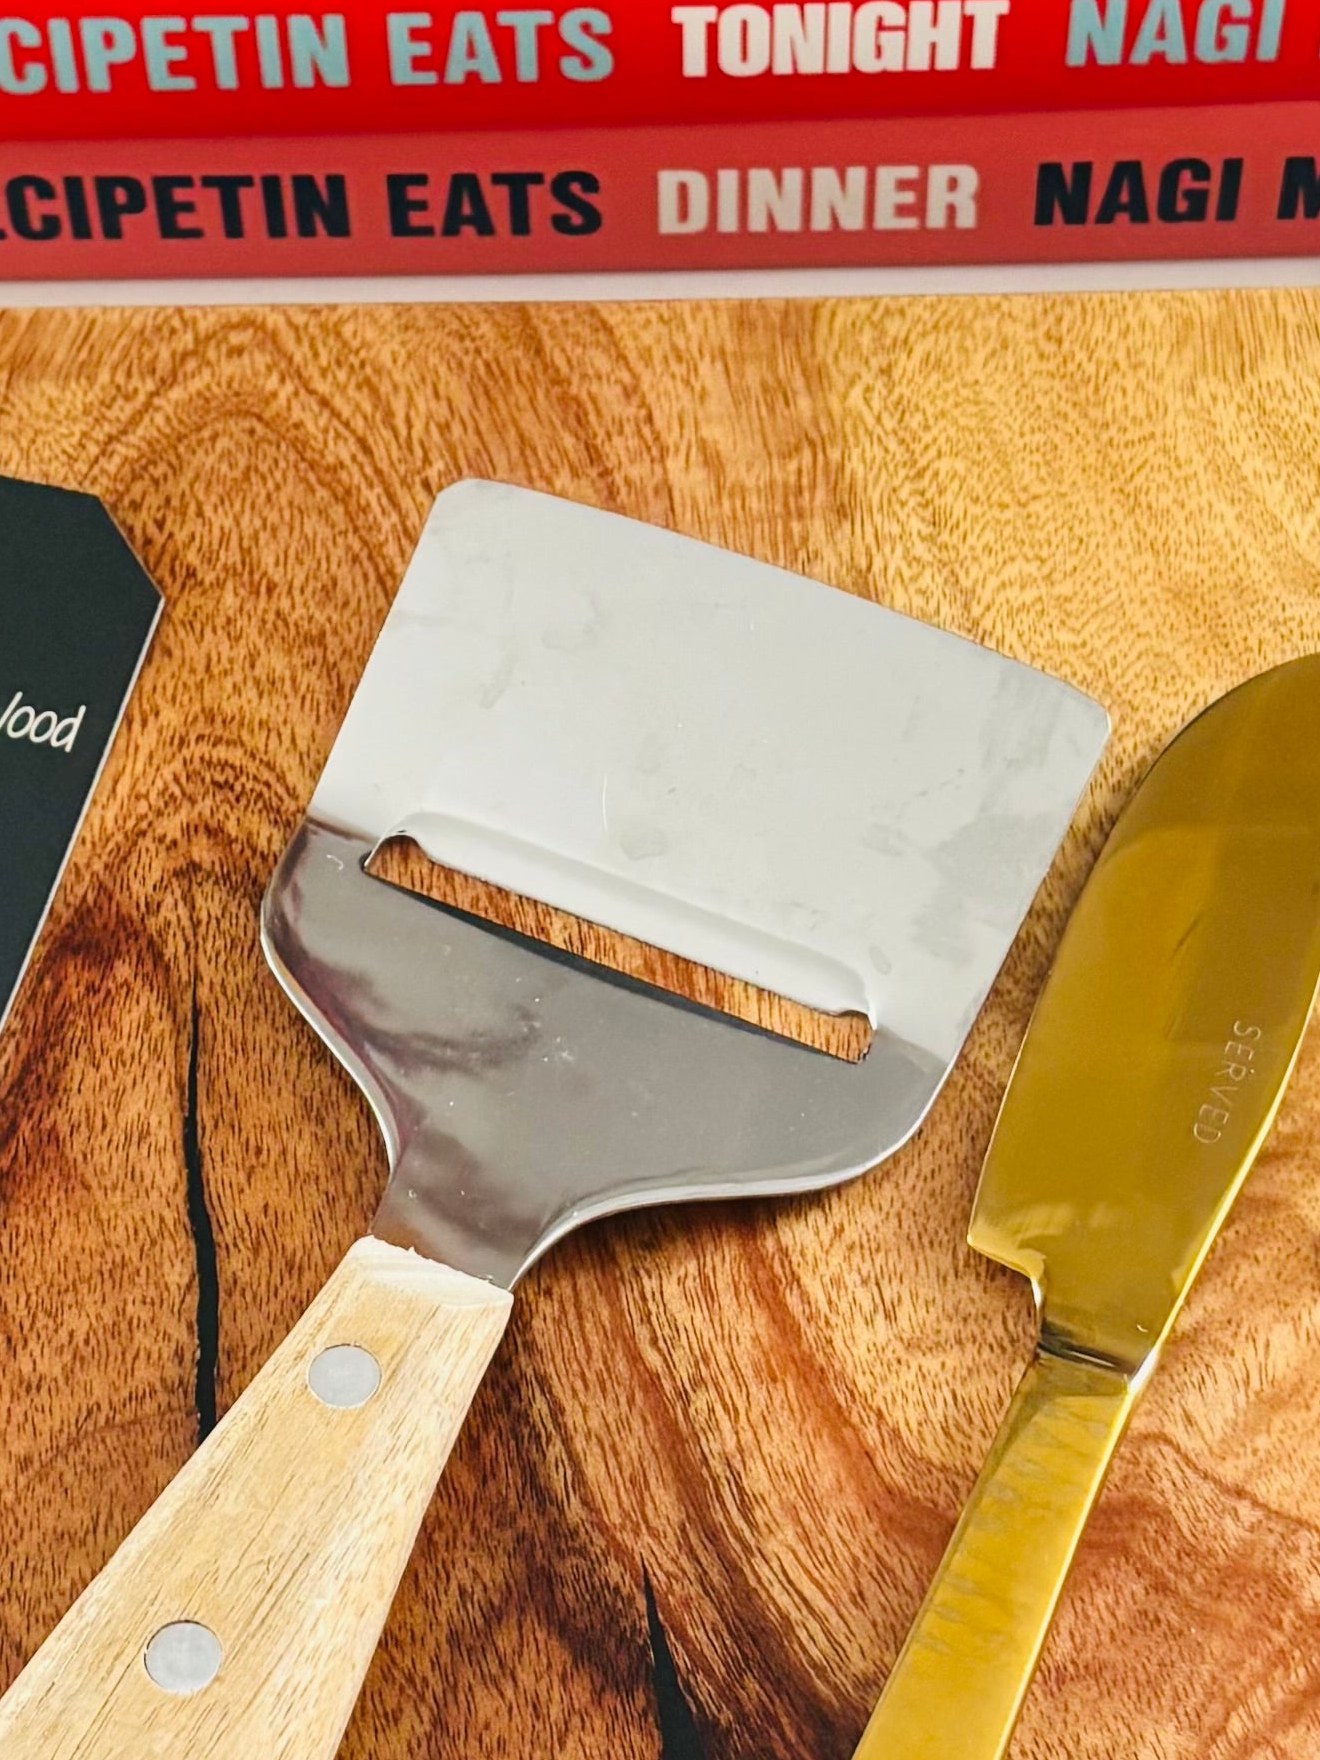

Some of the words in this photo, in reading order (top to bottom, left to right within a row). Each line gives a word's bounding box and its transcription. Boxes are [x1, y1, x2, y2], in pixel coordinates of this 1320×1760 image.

[385, 6, 615, 86] EATS
[384, 170, 603, 237] EATS
[657, 164, 980, 235] DINNER
[1033, 158, 1244, 226] NAGI
[1192, 1019, 1262, 1145] SERVED
